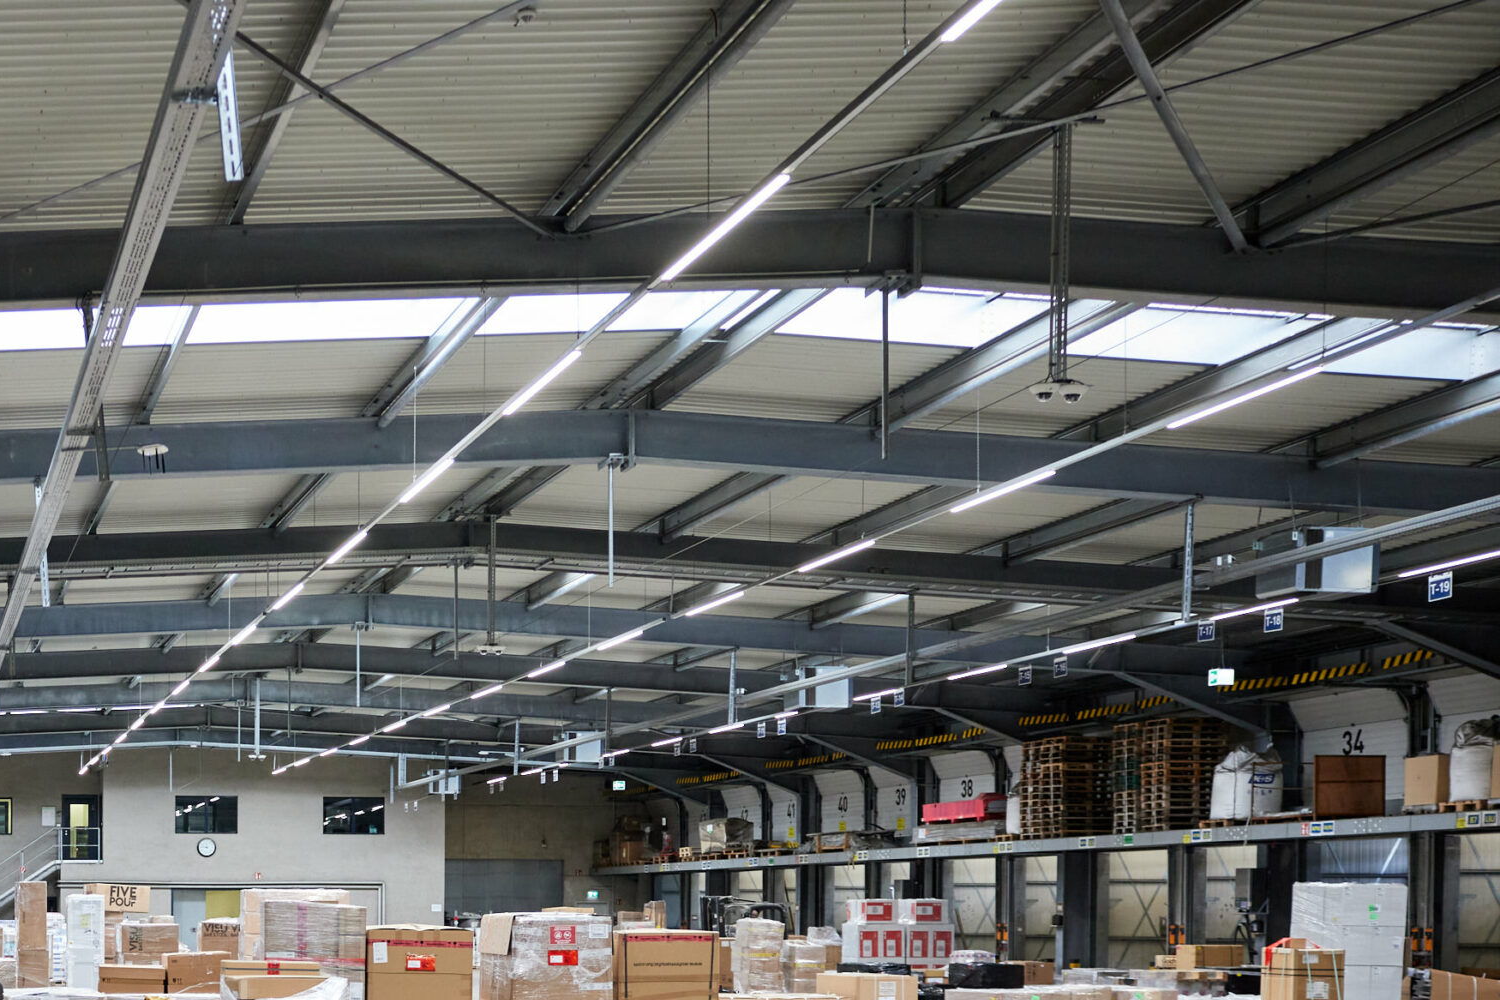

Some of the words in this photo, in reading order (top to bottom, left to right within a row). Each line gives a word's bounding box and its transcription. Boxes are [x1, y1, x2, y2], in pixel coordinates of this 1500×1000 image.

[1430, 580, 1450, 595] T-19
[1265, 614, 1281, 627] T-18
[1200, 625, 1213, 637] T-17
[1342, 729, 1365, 755] 34
[961, 779, 974, 798] 38
[838, 796, 849, 813] 40
[896, 788, 907, 806] 39
[787, 803, 796, 818] 41
[110, 886, 137, 898] FIVE
[203, 923, 228, 933] VISU
